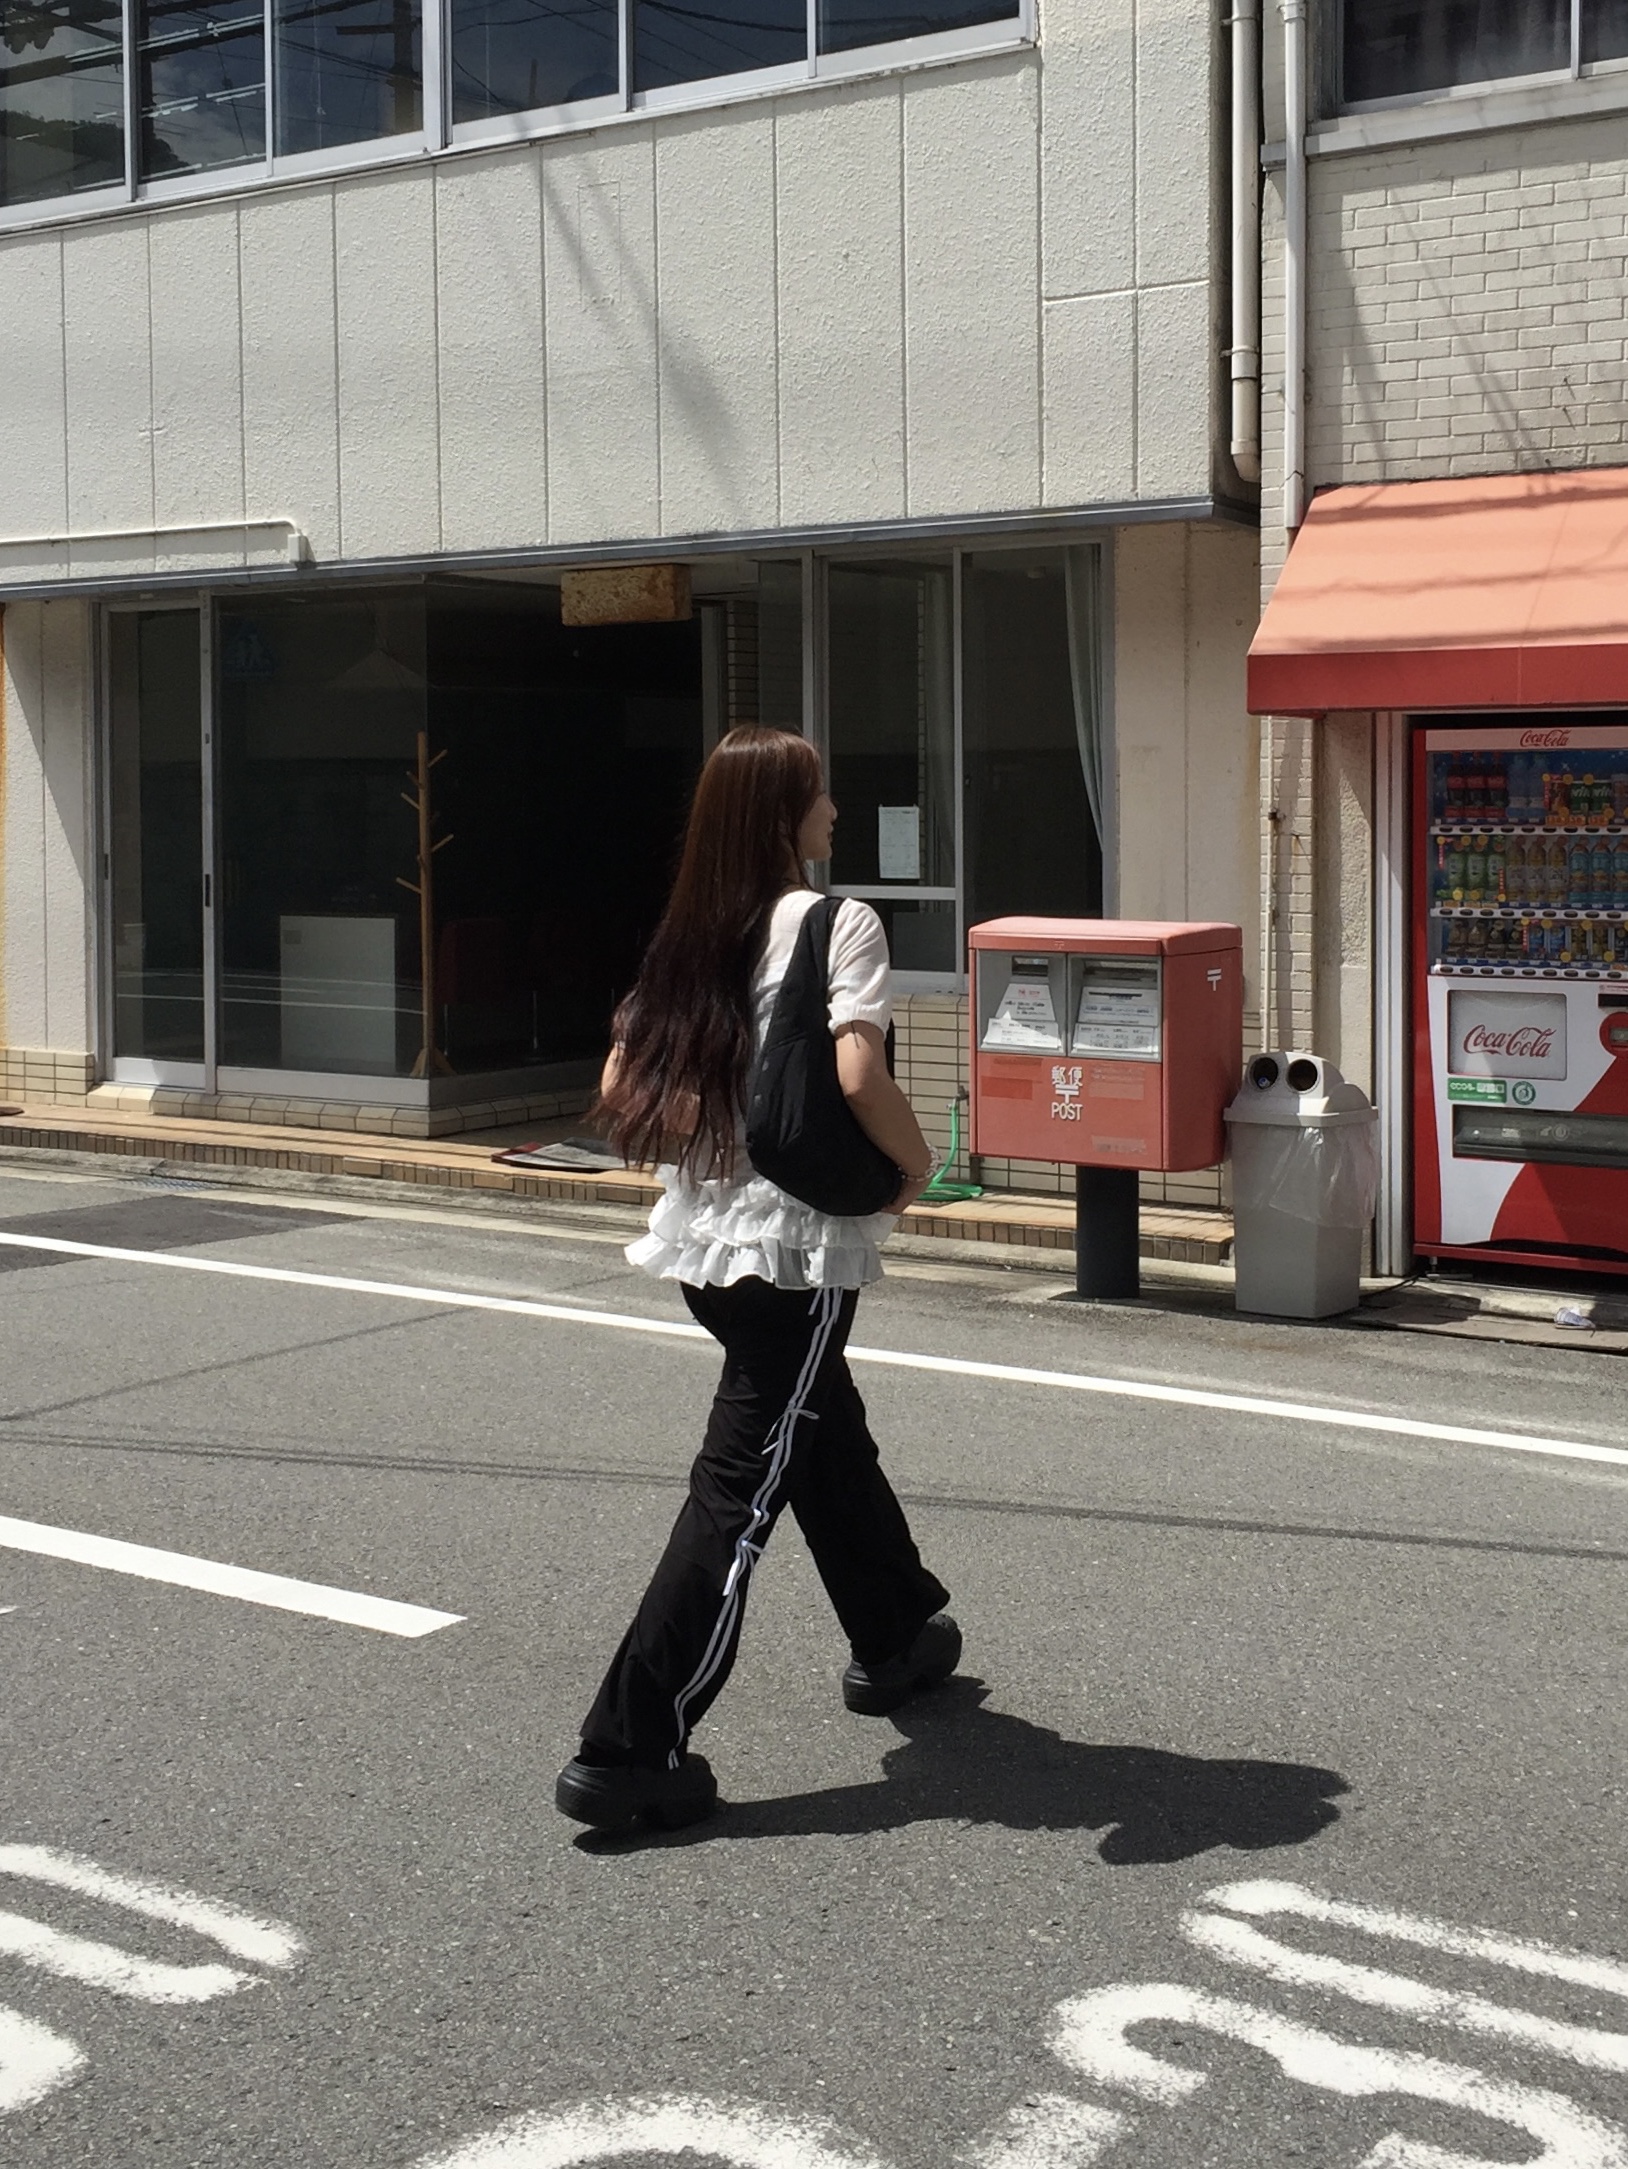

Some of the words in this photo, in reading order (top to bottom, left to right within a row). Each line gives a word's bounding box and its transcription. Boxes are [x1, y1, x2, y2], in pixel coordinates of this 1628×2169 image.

[1520, 730, 1571, 747] Coca-Cola
[1464, 1024, 1557, 1057] Coca-Cola
[1051, 1066, 1083, 1087] 郵便
[1051, 1102, 1083, 1121] POST
